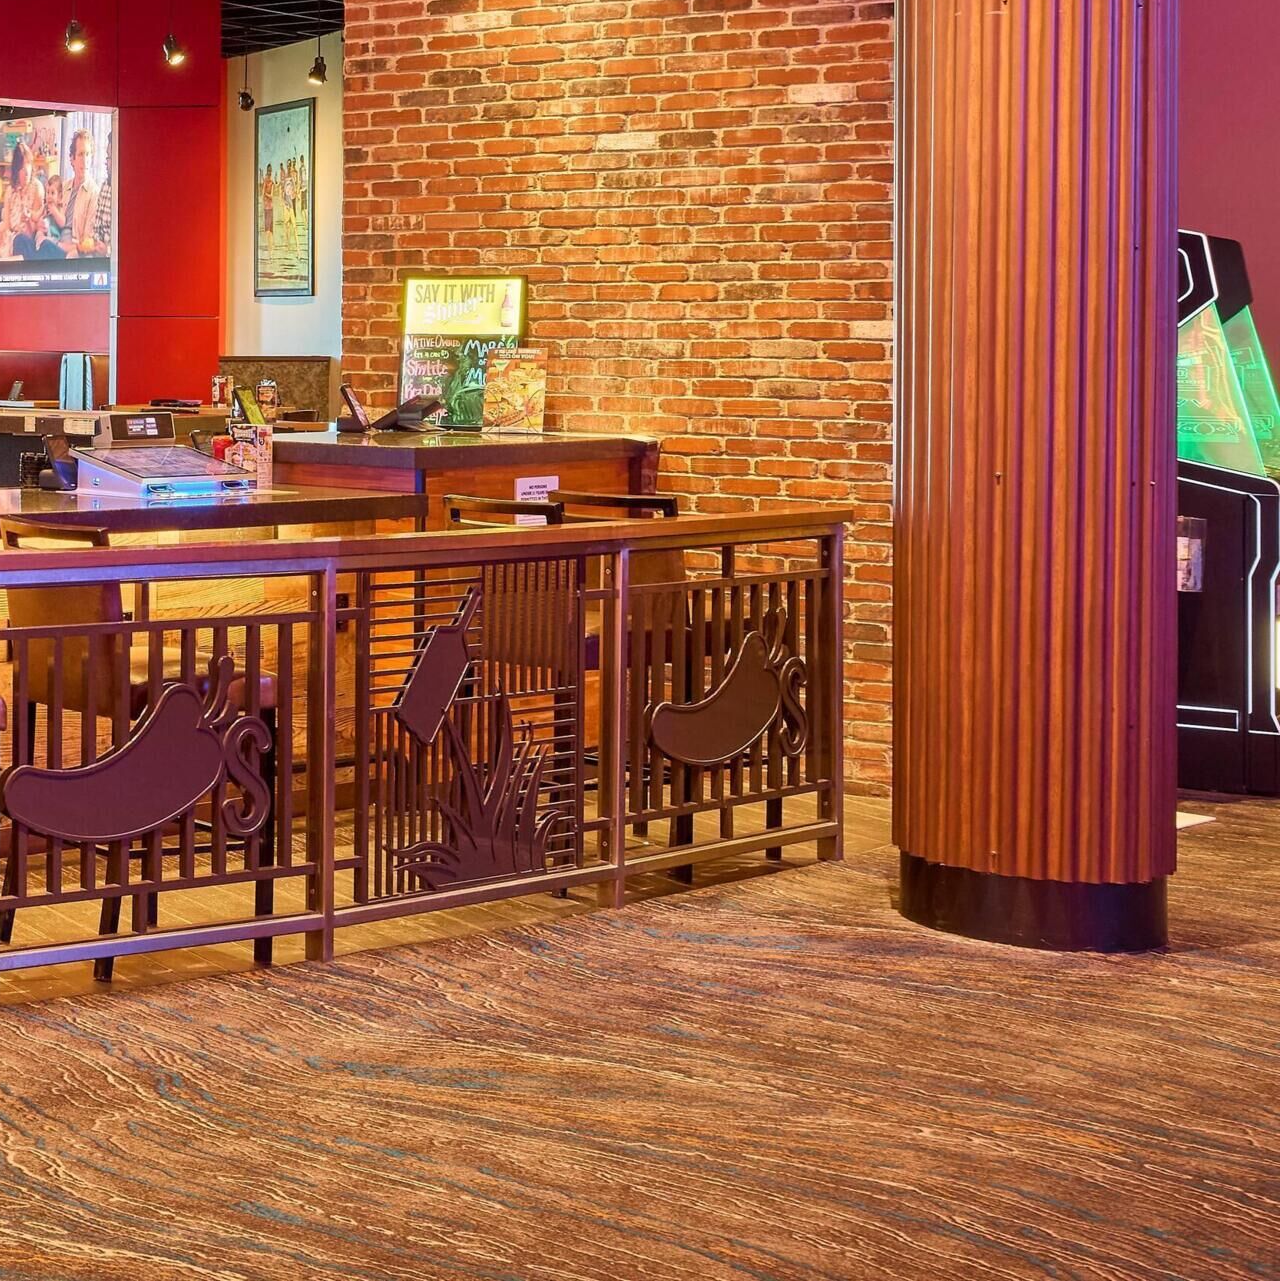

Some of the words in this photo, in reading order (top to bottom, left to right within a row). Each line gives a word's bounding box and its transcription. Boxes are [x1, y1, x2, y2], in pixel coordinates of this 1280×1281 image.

[415, 283, 440, 303] SAY
[444, 284, 457, 303] IT
[460, 284, 495, 303] WITH
